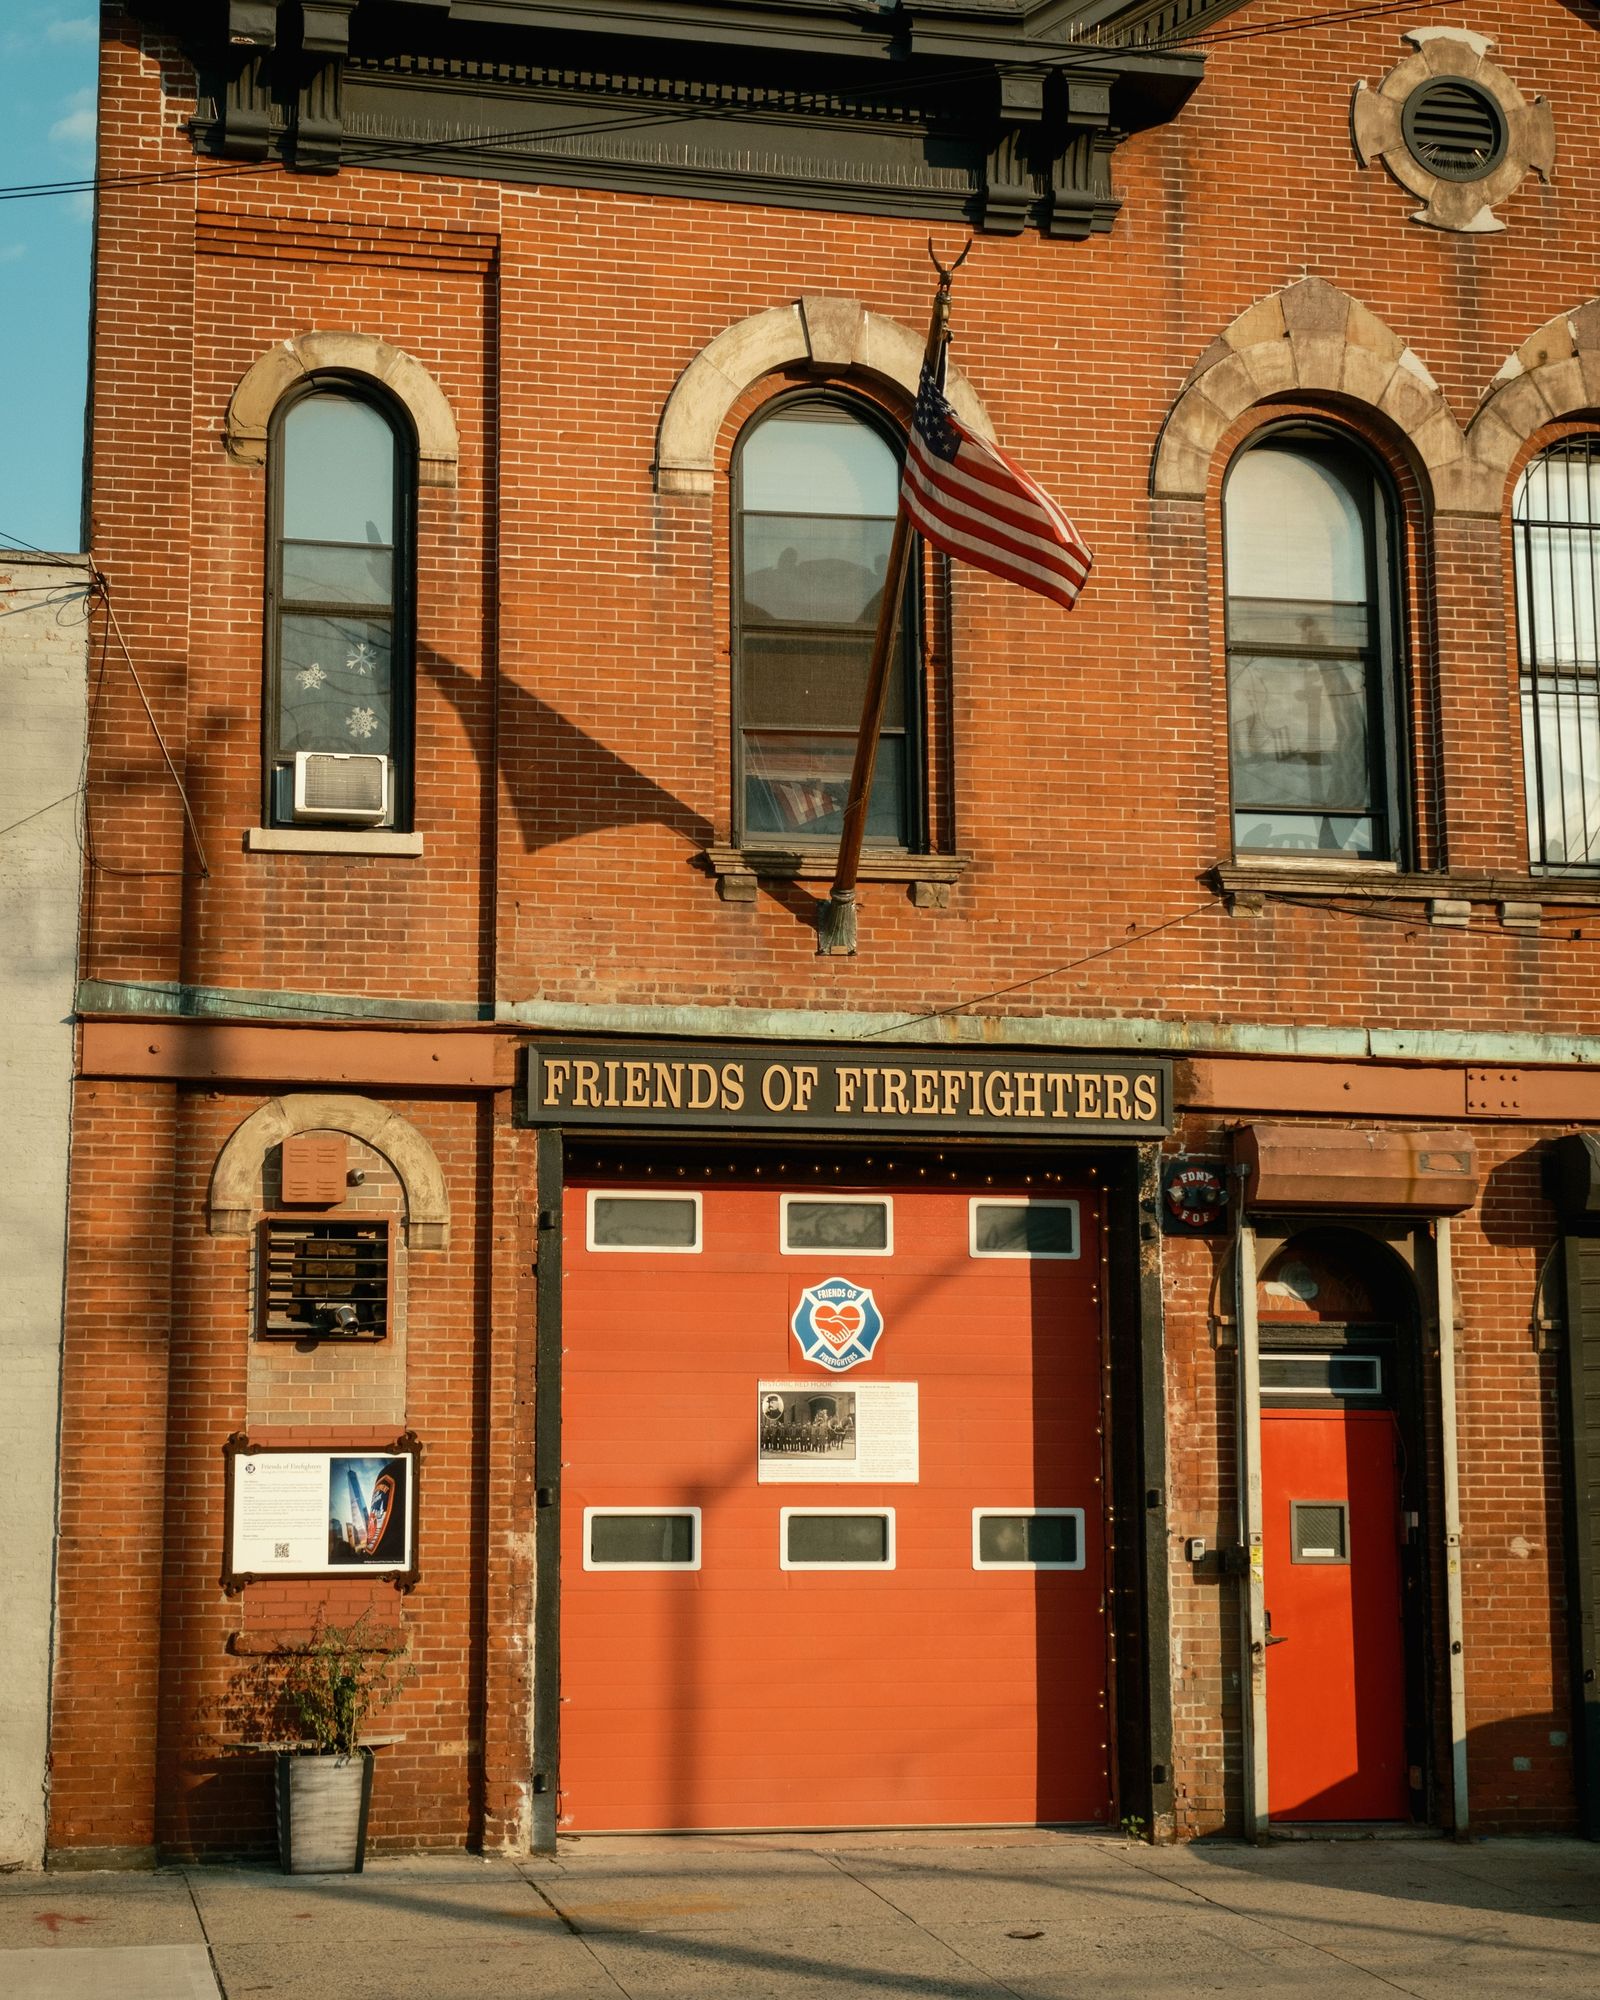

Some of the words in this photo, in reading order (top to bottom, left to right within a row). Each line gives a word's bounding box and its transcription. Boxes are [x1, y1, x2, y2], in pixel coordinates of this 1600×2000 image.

[543, 1060, 745, 1111] FRIENDS
[762, 1064, 818, 1112] OF
[834, 1067, 1157, 1121] FIREFIGHTERS
[1180, 1171, 1214, 1184] FDNY
[817, 1288, 846, 1300] FRIENDS
[847, 1289, 858, 1300] OF
[818, 1352, 859, 1367] FIREFIGHTERS
[260, 1463, 281, 1471] Friends
[282, 1463, 290, 1471] of
[290, 1463, 322, 1472] Firefighters
